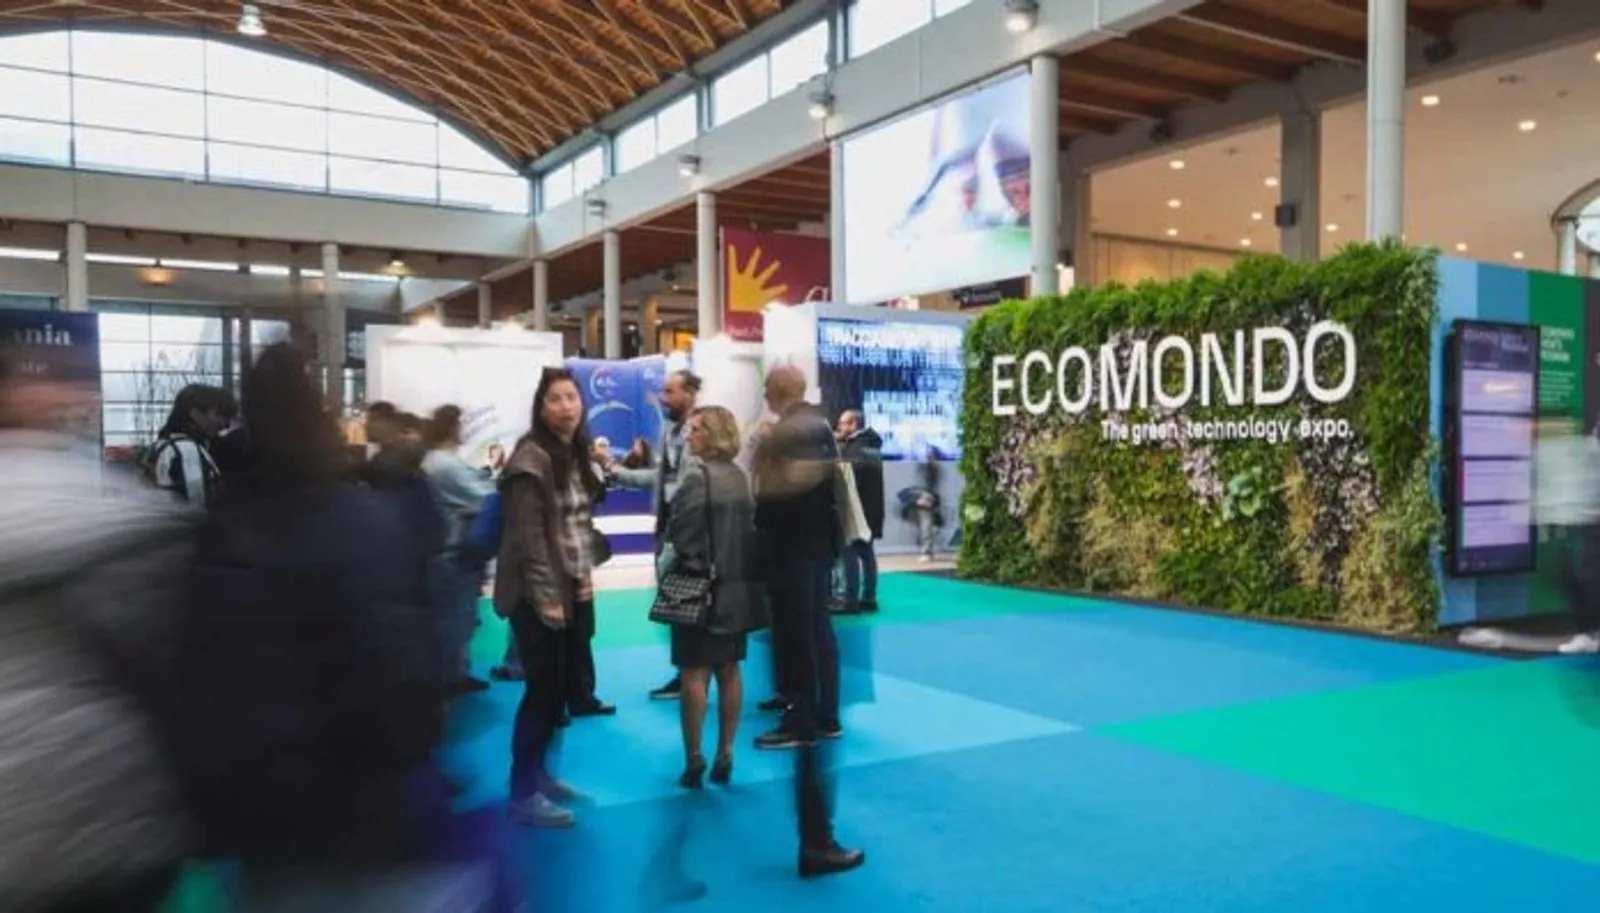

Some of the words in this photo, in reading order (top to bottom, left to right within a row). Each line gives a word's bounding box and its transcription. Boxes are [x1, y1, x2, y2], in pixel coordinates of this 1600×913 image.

[992, 320, 1357, 415] ECOMONDO
[1101, 419, 1128, 440] The
[1132, 420, 1178, 445] green
[1188, 416, 1290, 444] technology
[1300, 416, 1355, 443] expo.
